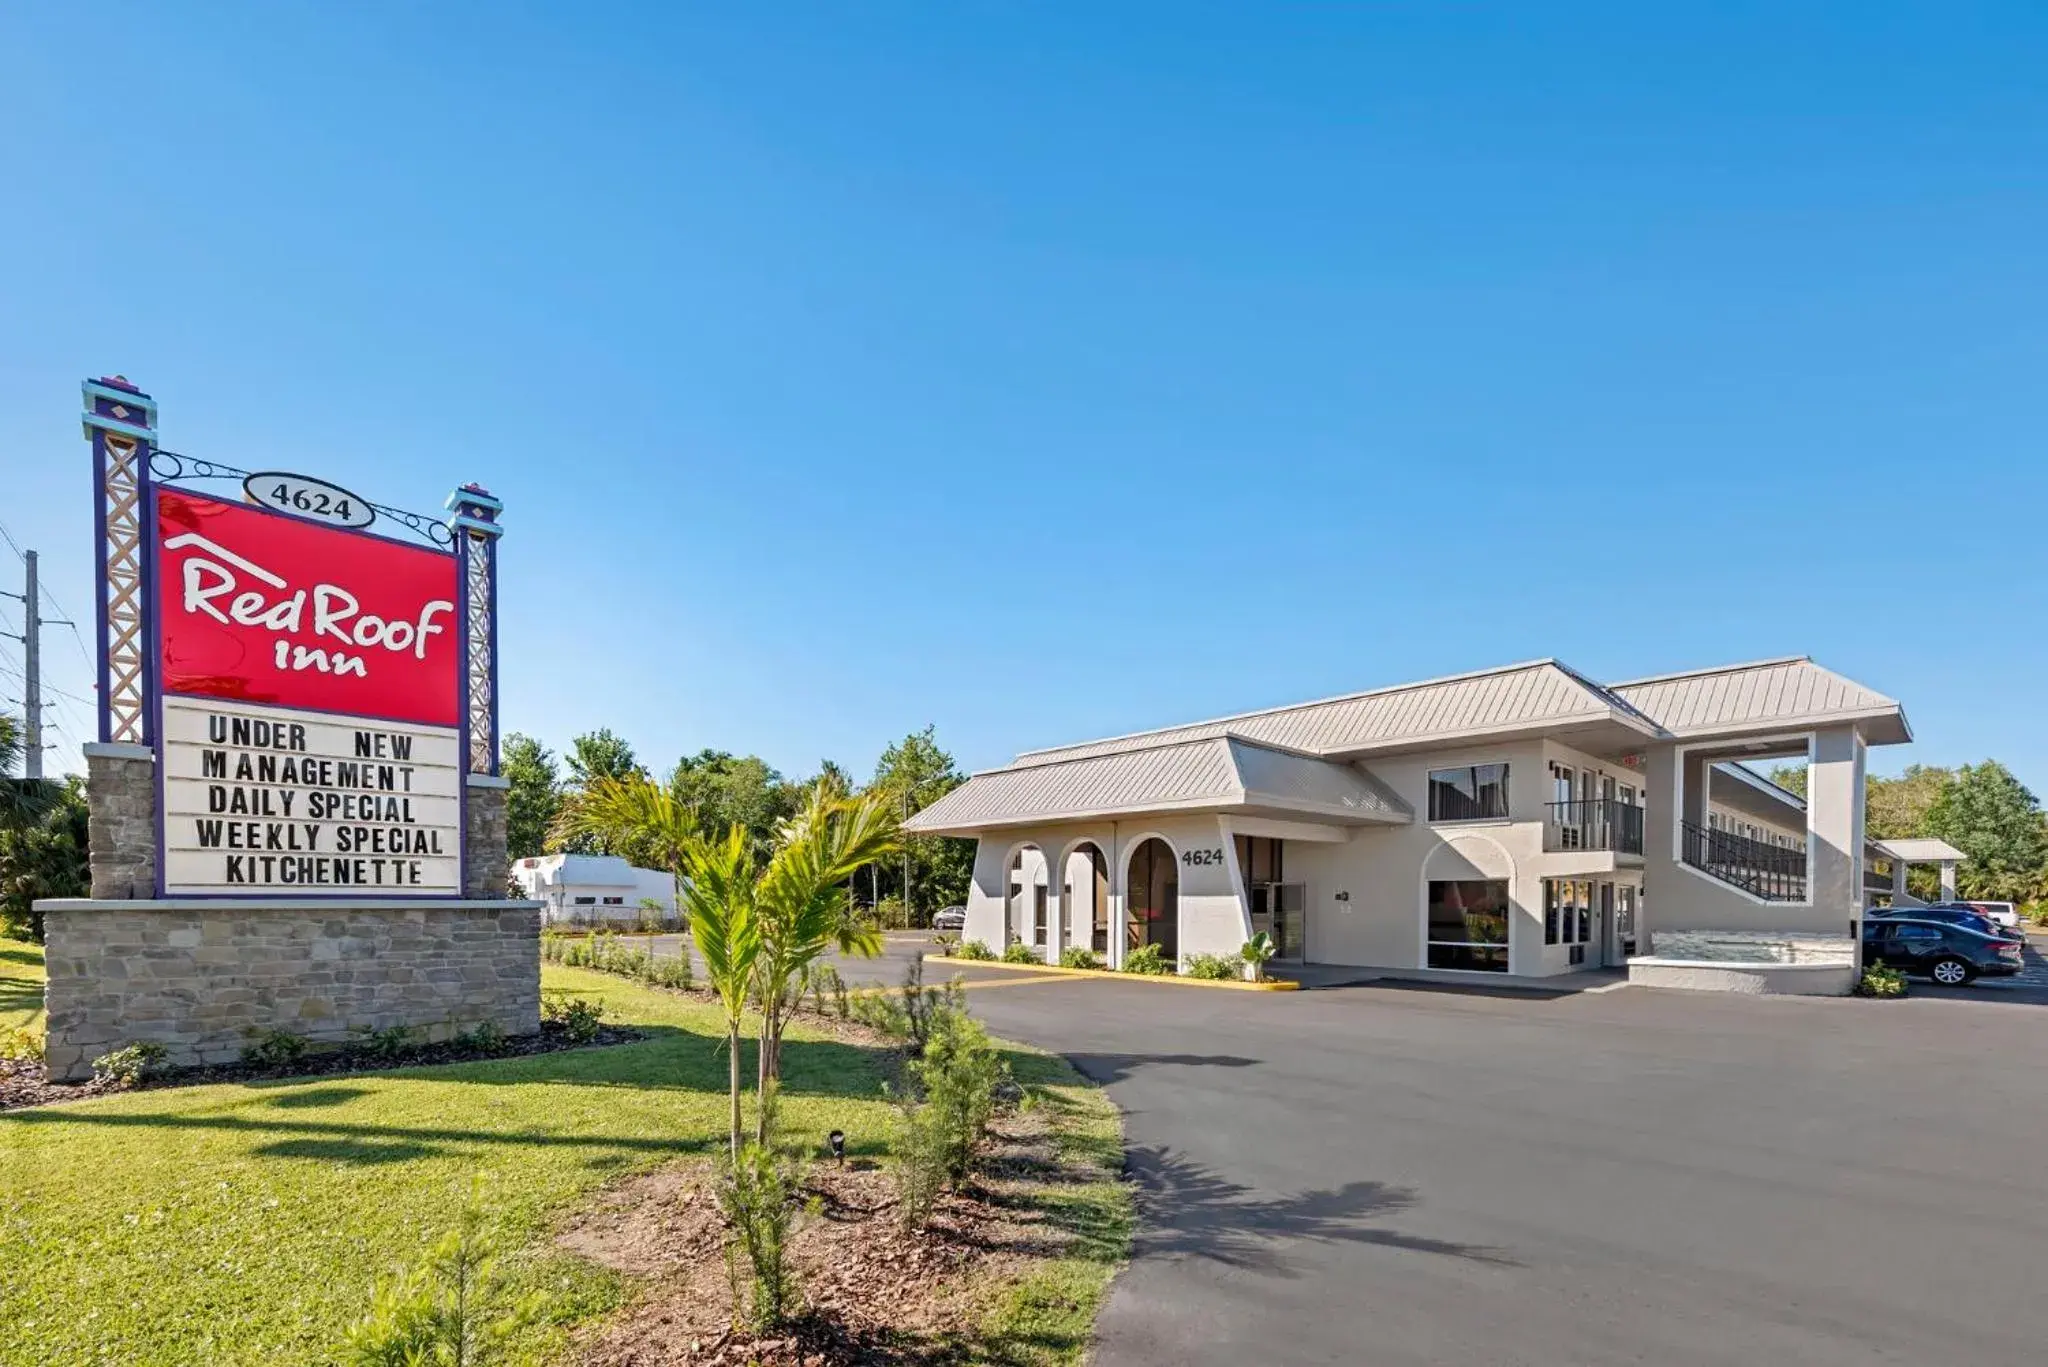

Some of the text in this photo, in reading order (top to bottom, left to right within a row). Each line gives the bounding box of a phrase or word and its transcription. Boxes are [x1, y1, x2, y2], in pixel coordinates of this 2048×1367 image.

[270, 483, 352, 521] 4624
[182, 557, 454, 659] Red Roof
[209, 715, 413, 760] UNDER NEW
[202, 750, 415, 791] MANAGEMENT
[209, 786, 415, 822] DAILY SPECIAL
[196, 819, 443, 855] WEEKLY SPECIAL
[226, 855, 422, 884] KITCHENETTE
[1182, 848, 1224, 866] 4624
